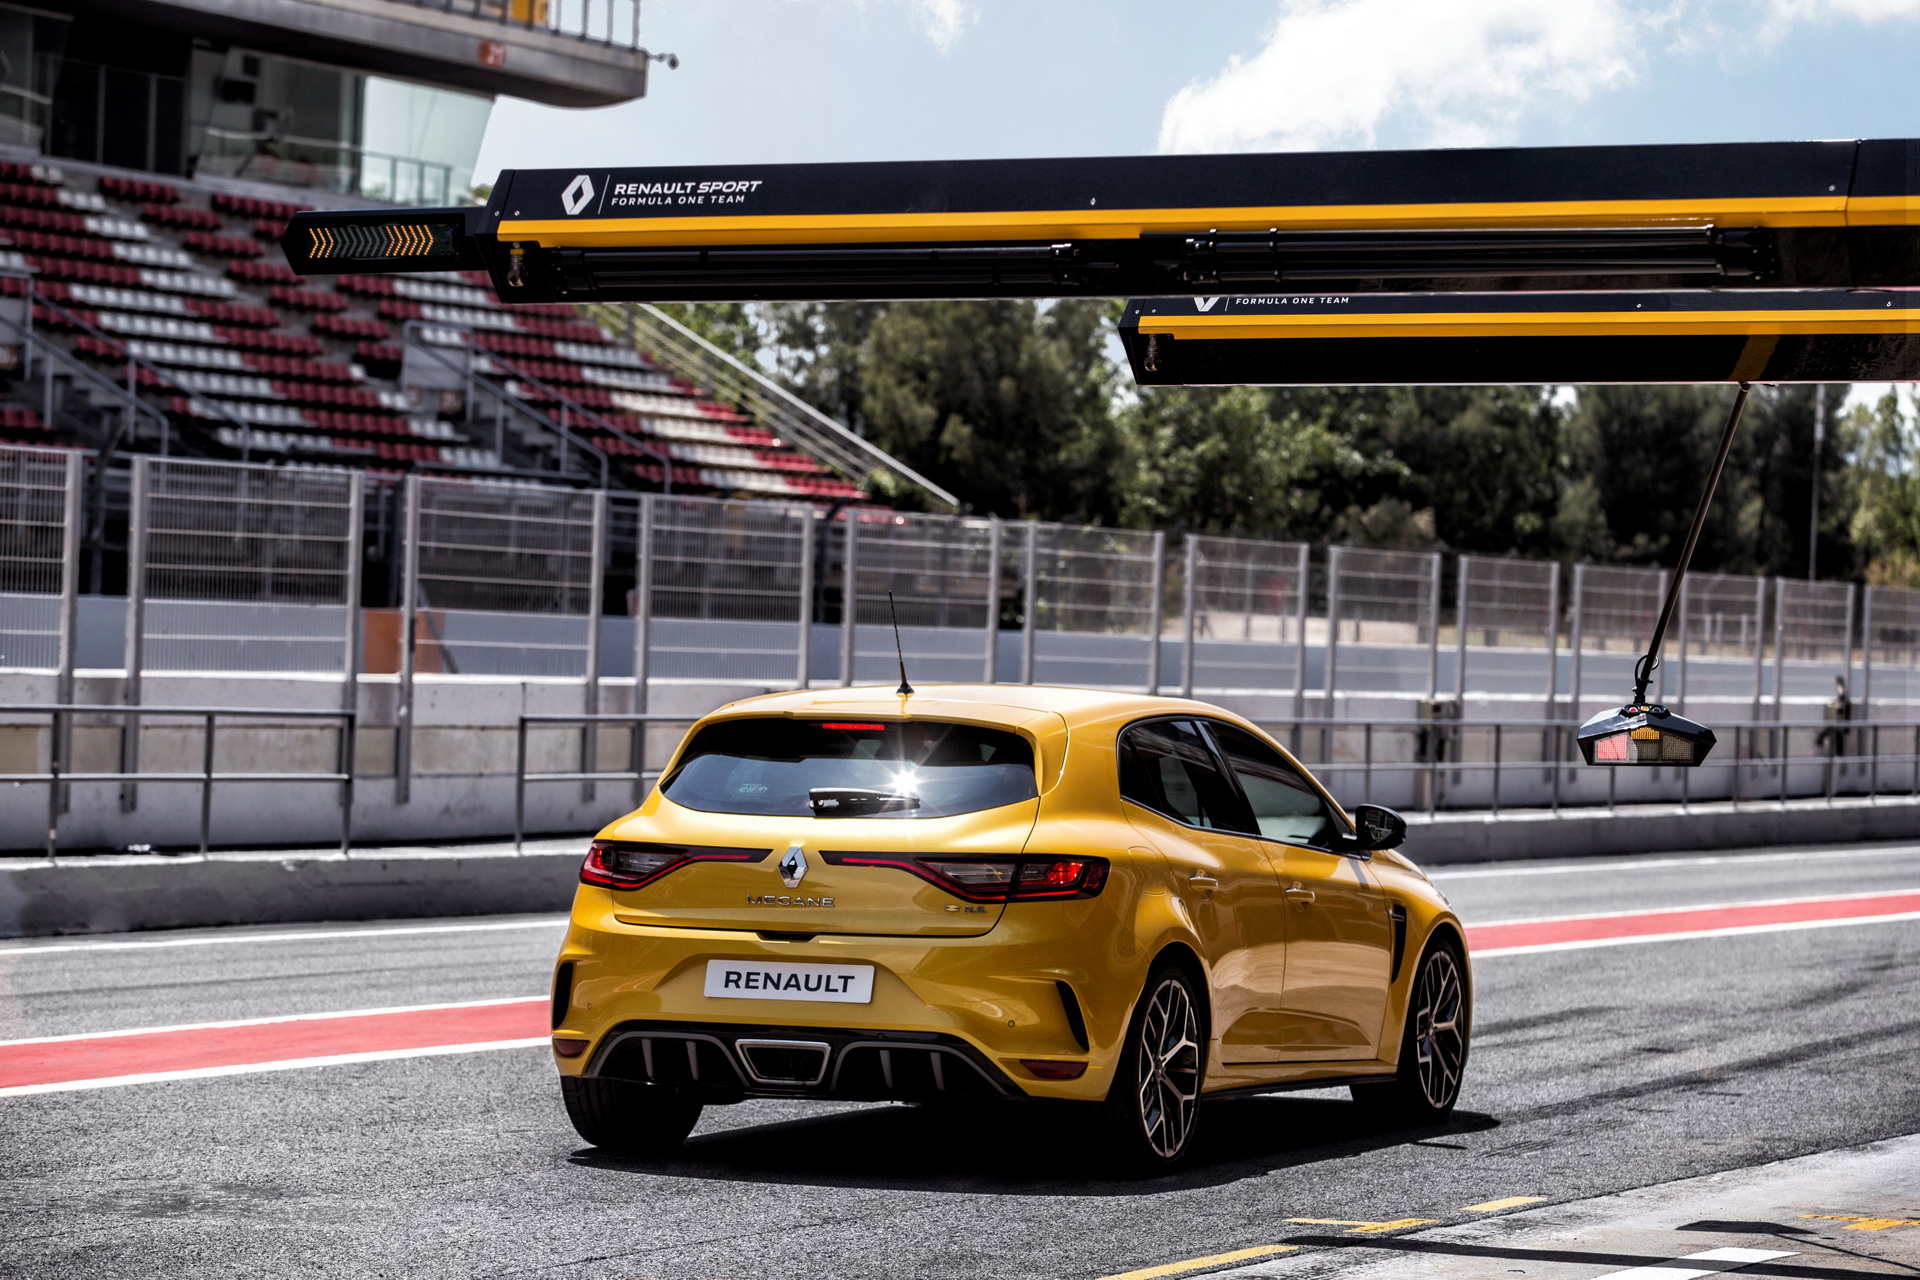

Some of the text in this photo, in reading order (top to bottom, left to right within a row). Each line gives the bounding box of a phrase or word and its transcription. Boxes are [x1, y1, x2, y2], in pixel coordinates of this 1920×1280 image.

[614, 180, 763, 195] RENAULT SPORT
[611, 194, 745, 206] FORMULA ONE TEAM
[1235, 297, 1288, 305] FORMULA
[1320, 296, 1349, 304] TEAM
[746, 894, 835, 907] MEGANE
[723, 970, 855, 993] RENAULT
